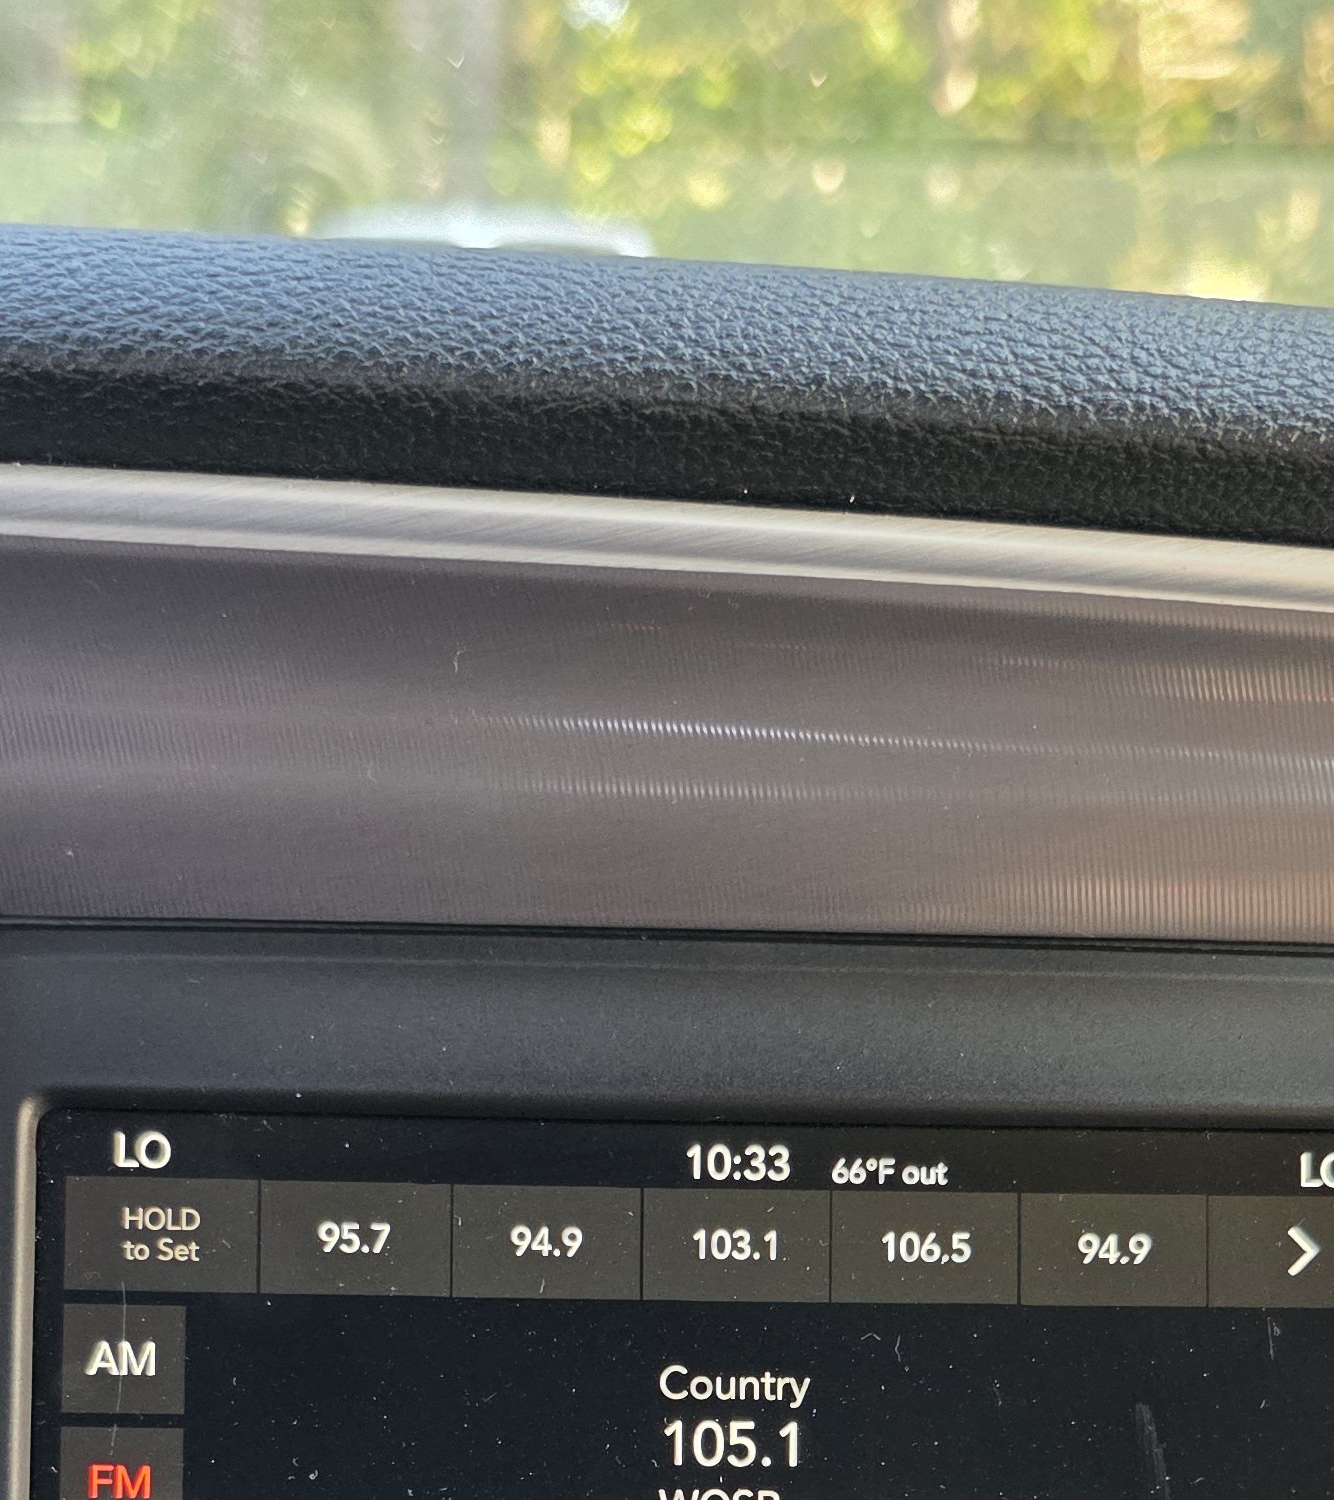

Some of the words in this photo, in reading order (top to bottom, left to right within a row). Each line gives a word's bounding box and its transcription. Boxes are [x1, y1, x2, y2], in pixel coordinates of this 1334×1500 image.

[113, 1130, 172, 1170] LO
[686, 1143, 791, 1182] 10:33
[901, 1161, 949, 1186] out
[121, 1206, 201, 1231] HOLD
[122, 1240, 150, 1261] to
[156, 1237, 200, 1262] Set
[317, 1221, 391, 1254] 95.7
[510, 1224, 583, 1258] 94.9
[692, 1228, 777, 1261] 103.1
[881, 1231, 972, 1264] 106.5
[1077, 1232, 1152, 1265] 94.9
[85, 1338, 156, 1377] AM
[659, 1364, 811, 1409] Country
[663, 1419, 798, 1468] 105.1
[87, 1463, 151, 1500] FM
